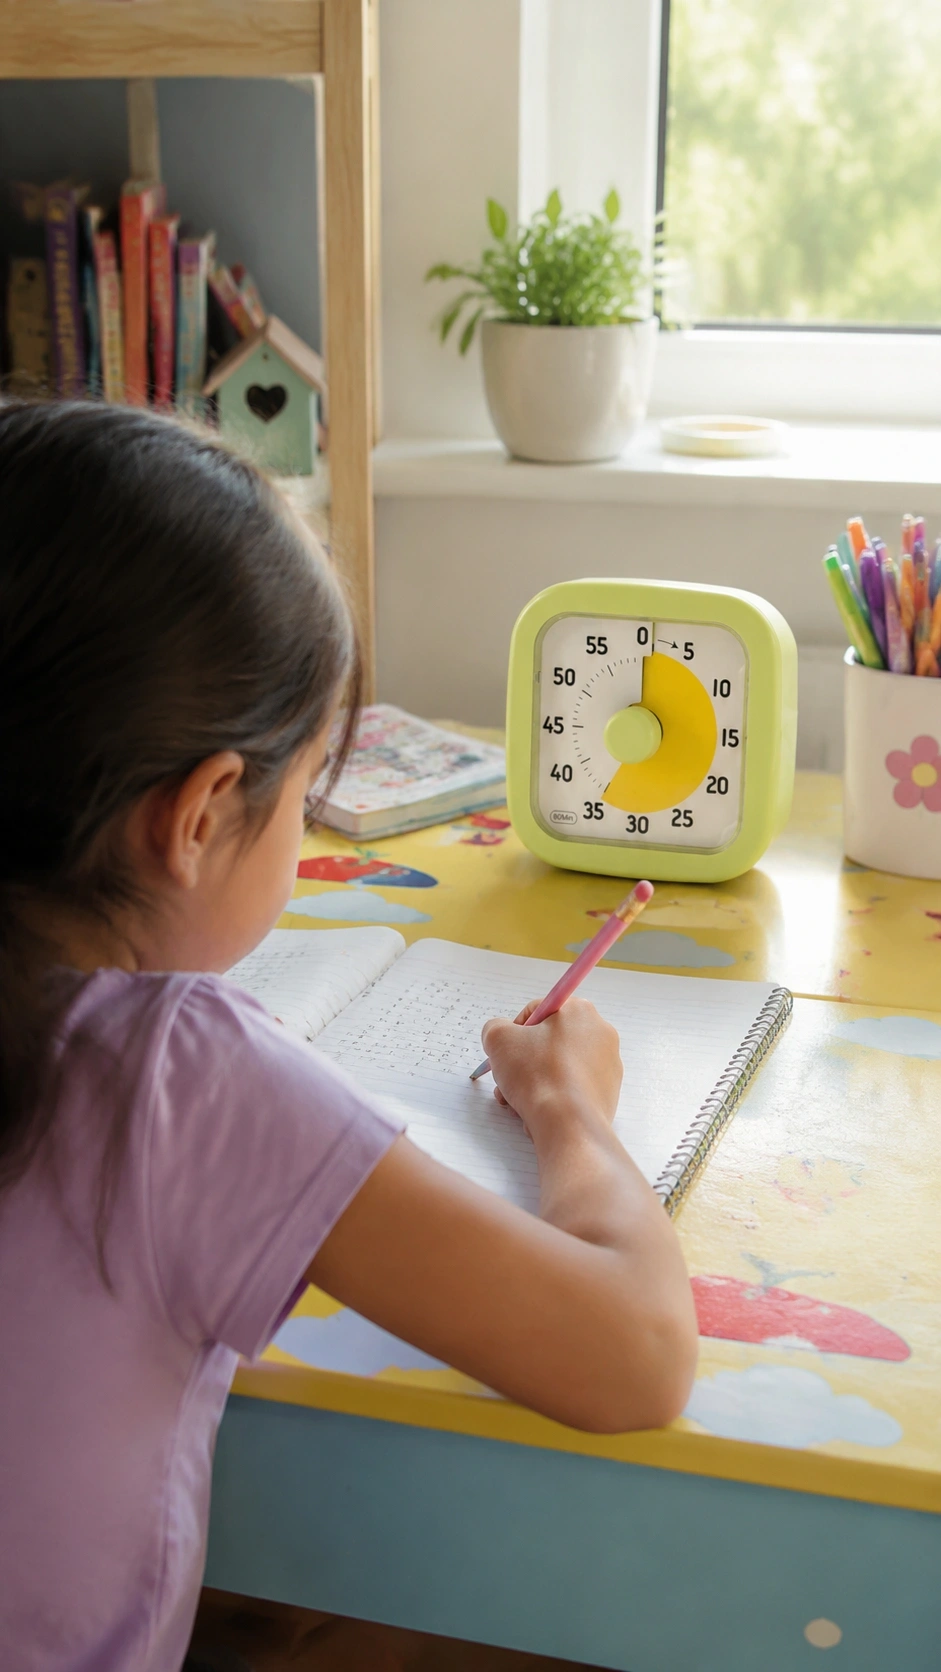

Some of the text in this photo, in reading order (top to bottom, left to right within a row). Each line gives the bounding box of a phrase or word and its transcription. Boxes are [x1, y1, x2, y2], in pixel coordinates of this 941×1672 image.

[637, 627, 648, 645] 0
[586, 636, 608, 655] 55
[684, 642, 694, 660] 5
[553, 667, 575, 686] 50
[713, 679, 731, 698] 10
[543, 716, 564, 734] 45
[722, 728, 739, 747] 15
[550, 764, 572, 782] 40
[707, 776, 728, 795] 20
[583, 802, 604, 820] 35
[672, 809, 693, 827] 25
[626, 815, 649, 834] 30
